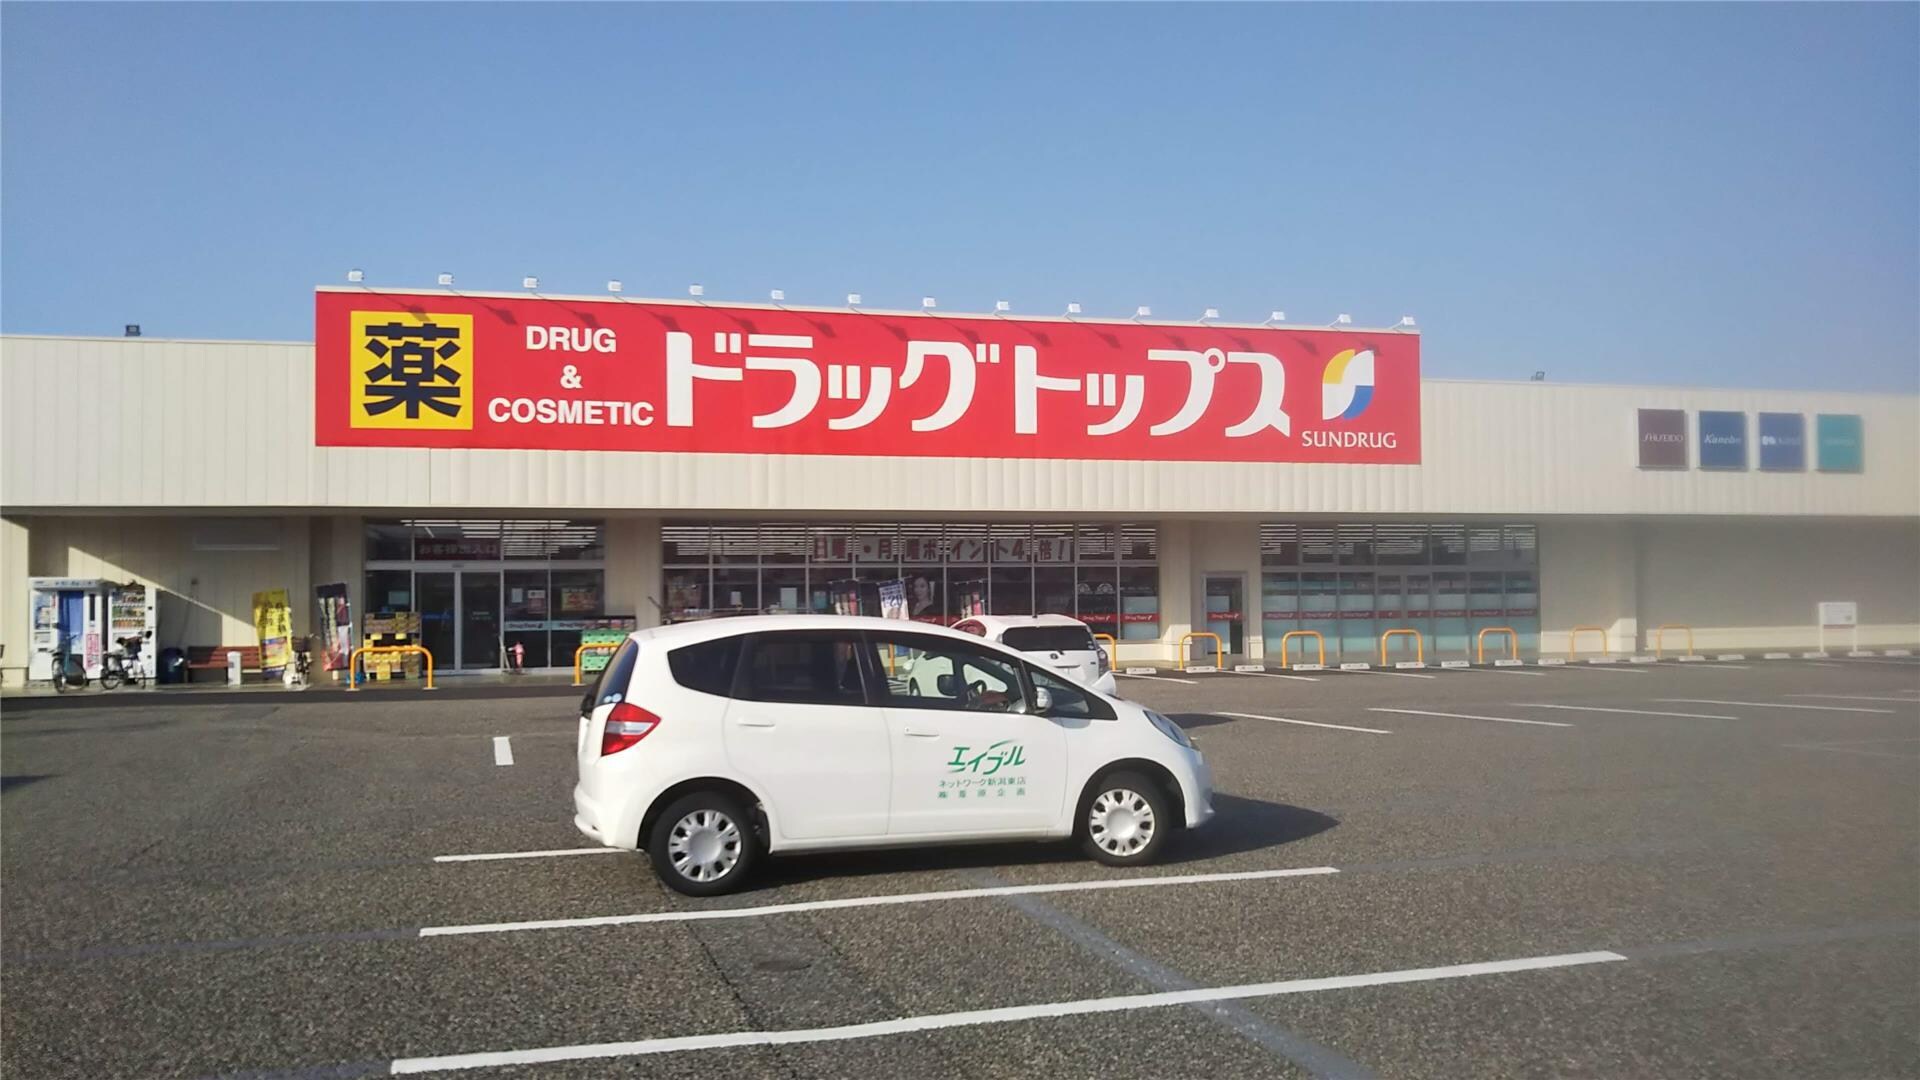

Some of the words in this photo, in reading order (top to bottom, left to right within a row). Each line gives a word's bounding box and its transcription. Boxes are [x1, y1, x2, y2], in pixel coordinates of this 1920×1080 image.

[525, 325, 617, 352] DRUG
[363, 322, 463, 420] 薬
[560, 364, 583, 390] &
[666, 331, 1291, 438] ドラッグトップス
[487, 397, 654, 427] COSMETIC
[1301, 430, 1398, 449] SUNDRUG
[947, 739, 1026, 775] エイブル
